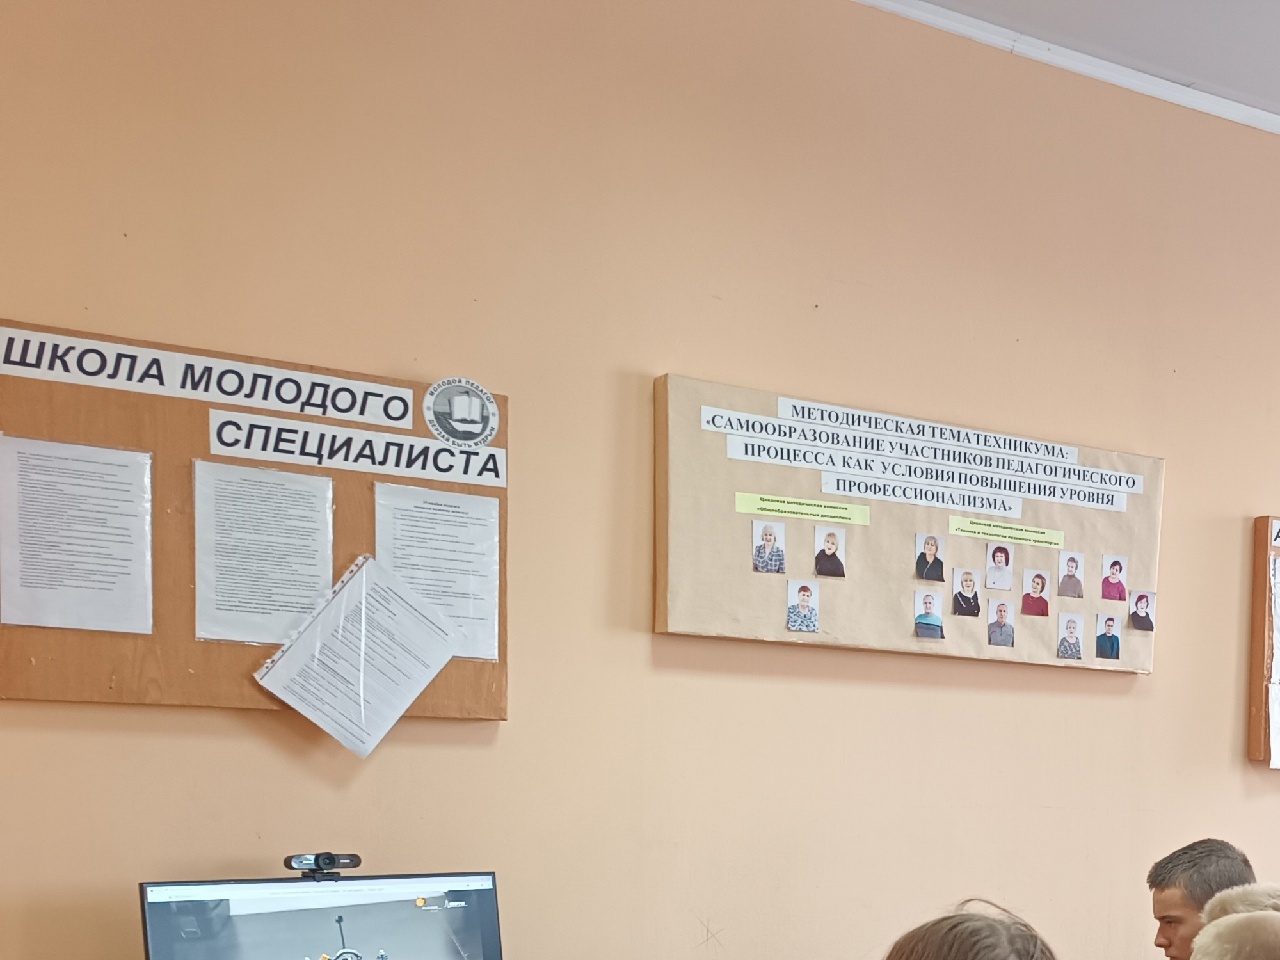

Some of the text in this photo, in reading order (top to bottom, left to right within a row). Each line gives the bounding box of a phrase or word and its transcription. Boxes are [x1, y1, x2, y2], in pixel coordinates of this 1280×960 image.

[2, 337, 409, 422] ШКОЛА МОЛОДОГО
[216, 420, 500, 478] СПЕЦИАЛИСТА
[706, 414, 1136, 489] «САМООБРАЗОВАНИЕ УЧАСТНИКОВ ПЕДАГОГИЧЕСКОГО
[791, 405, 1069, 460] МЕТОДИЧЕСКАЯ ТЕМА ТЕХНИКУМА:
[743, 443, 1115, 506] ПРОЦЕССА КАК УСЛОВИЯ ПОВЫШЕНИЯ УРОВНЯ
[836, 478, 1013, 512] ПРОФЕССИОНАЛИЗМА»
